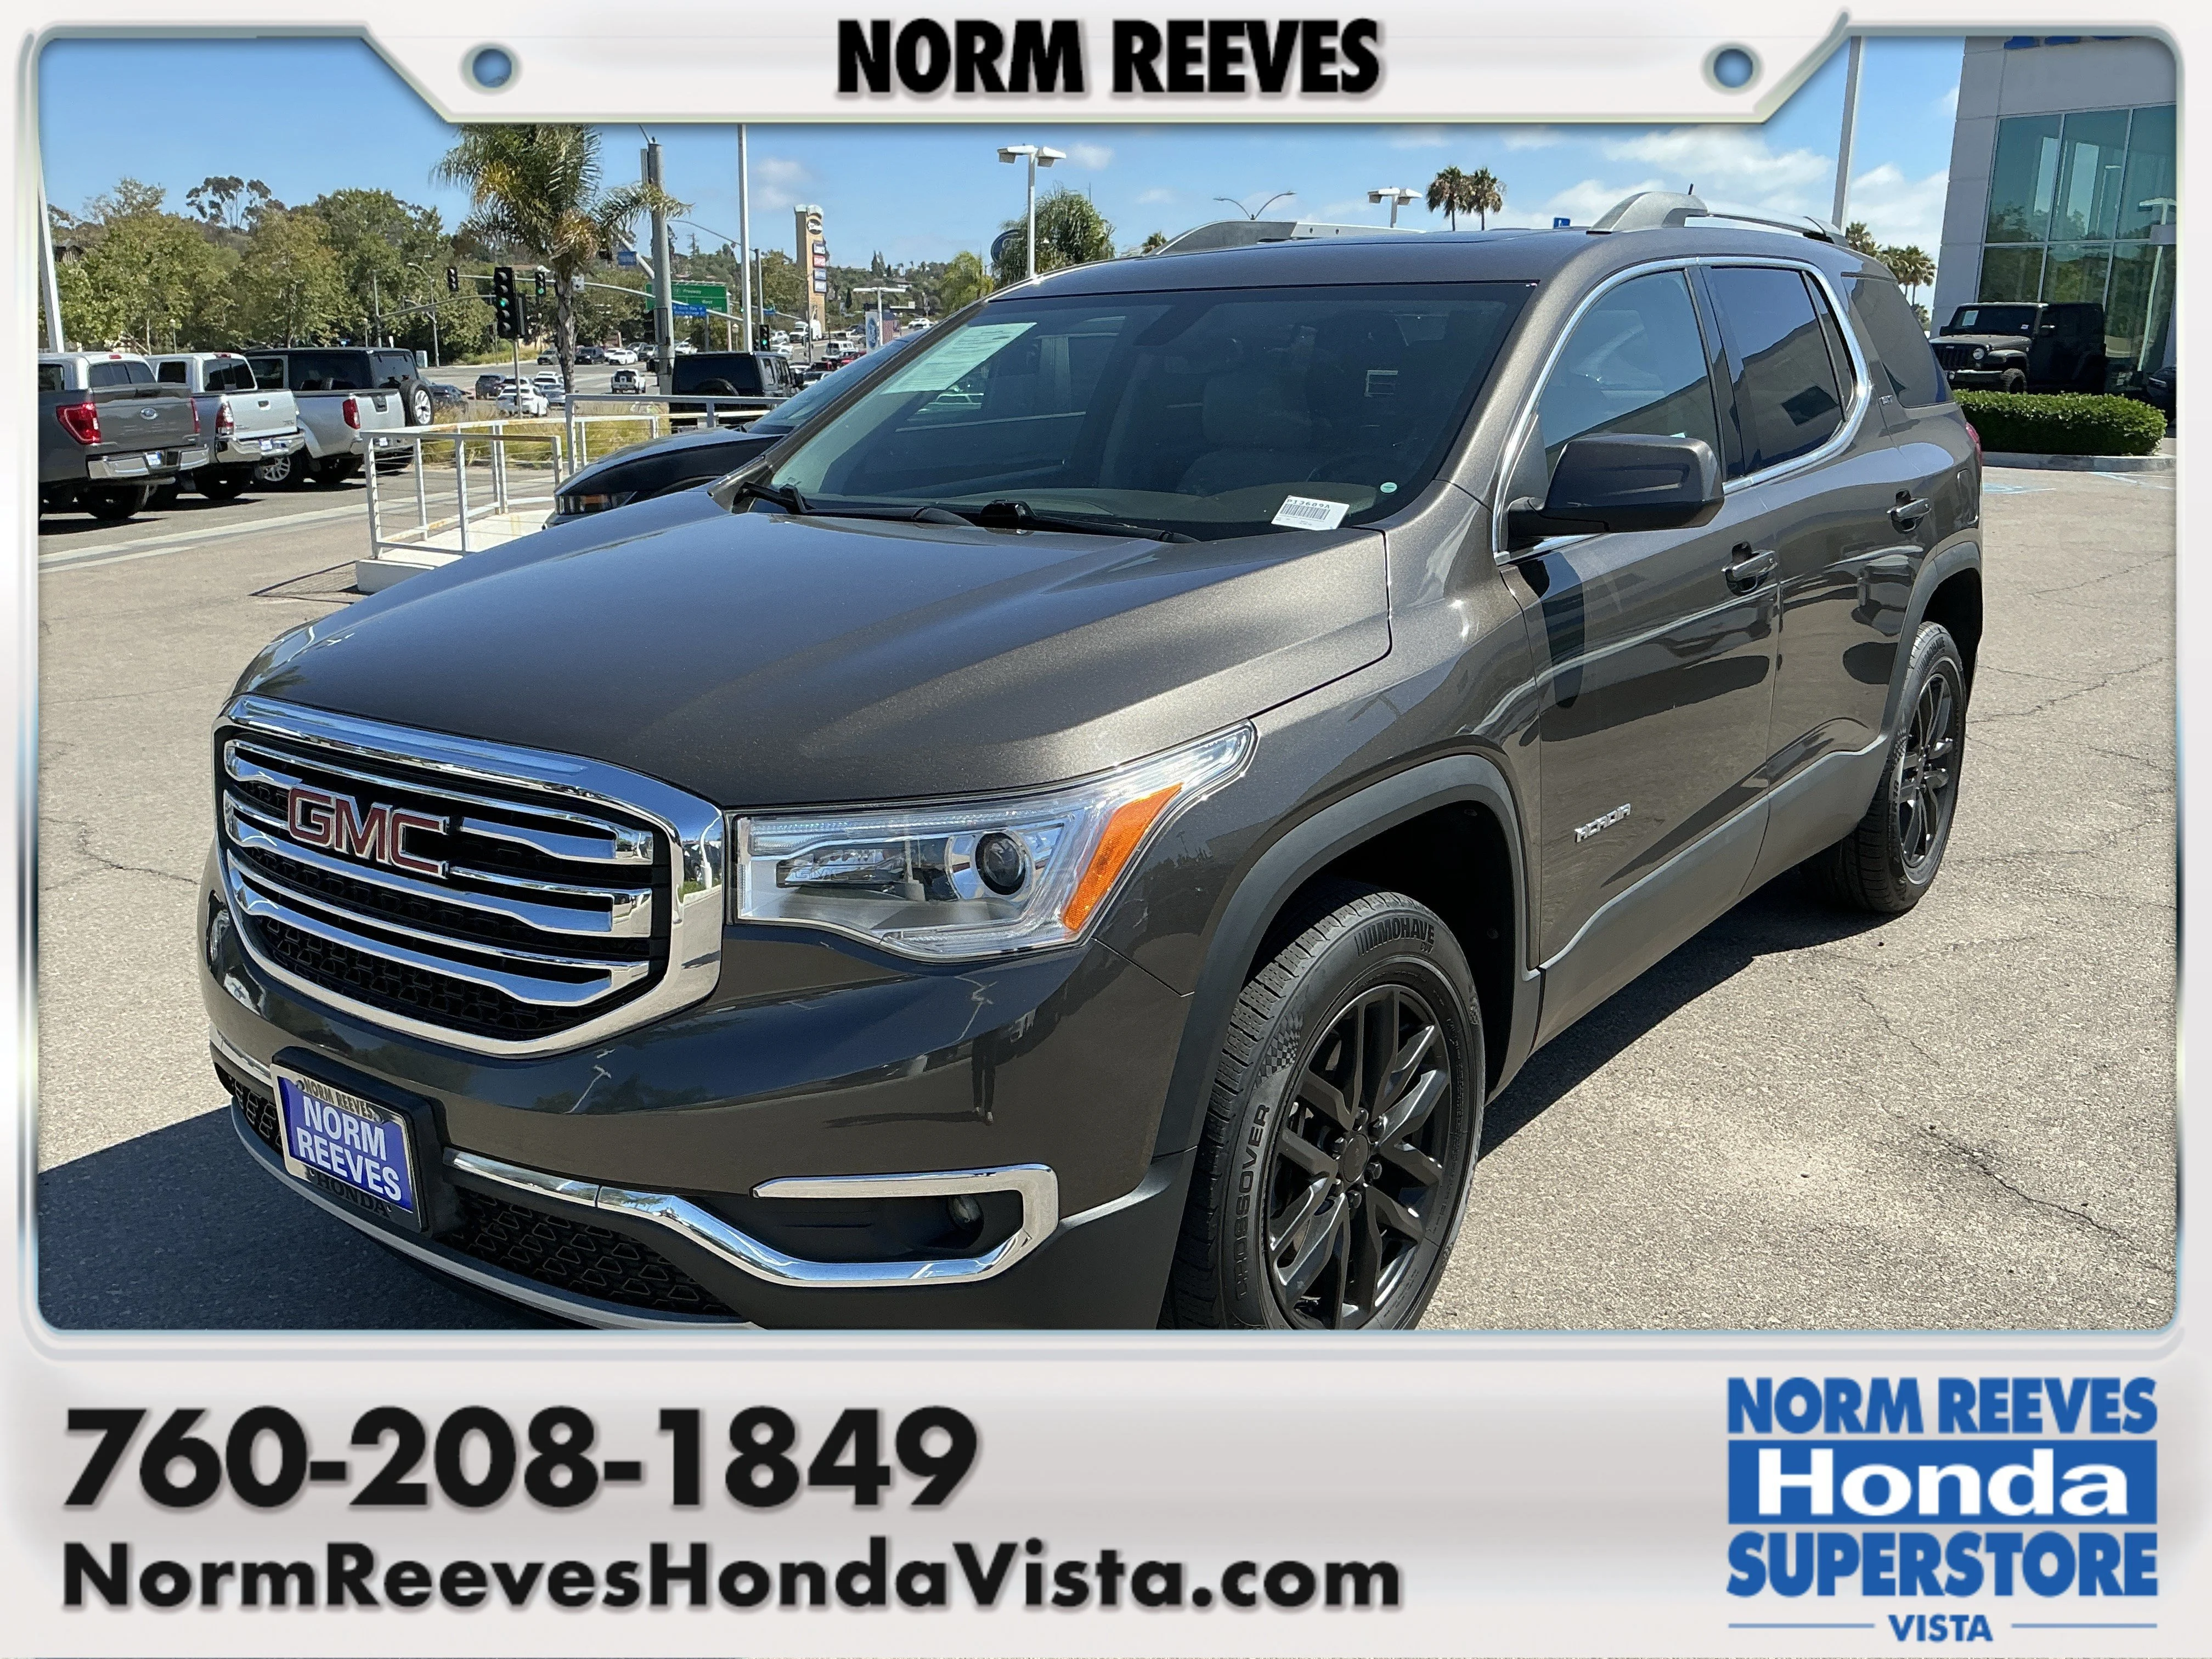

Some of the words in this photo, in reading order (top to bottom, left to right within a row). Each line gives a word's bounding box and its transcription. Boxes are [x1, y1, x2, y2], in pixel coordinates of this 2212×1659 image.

[289, 783, 450, 879] GMC
[1574, 803, 1631, 843] ACADIA
[1373, 917, 1435, 946] MOHAVE
[303, 1076, 335, 1104] NORM
[335, 1091, 374, 1120] REEVES
[303, 1095, 387, 1162] NORM
[296, 1126, 402, 1201] REEVES
[317, 1172, 393, 1220] HONDA
[1233, 1103, 1271, 1301] CROSSOVER
